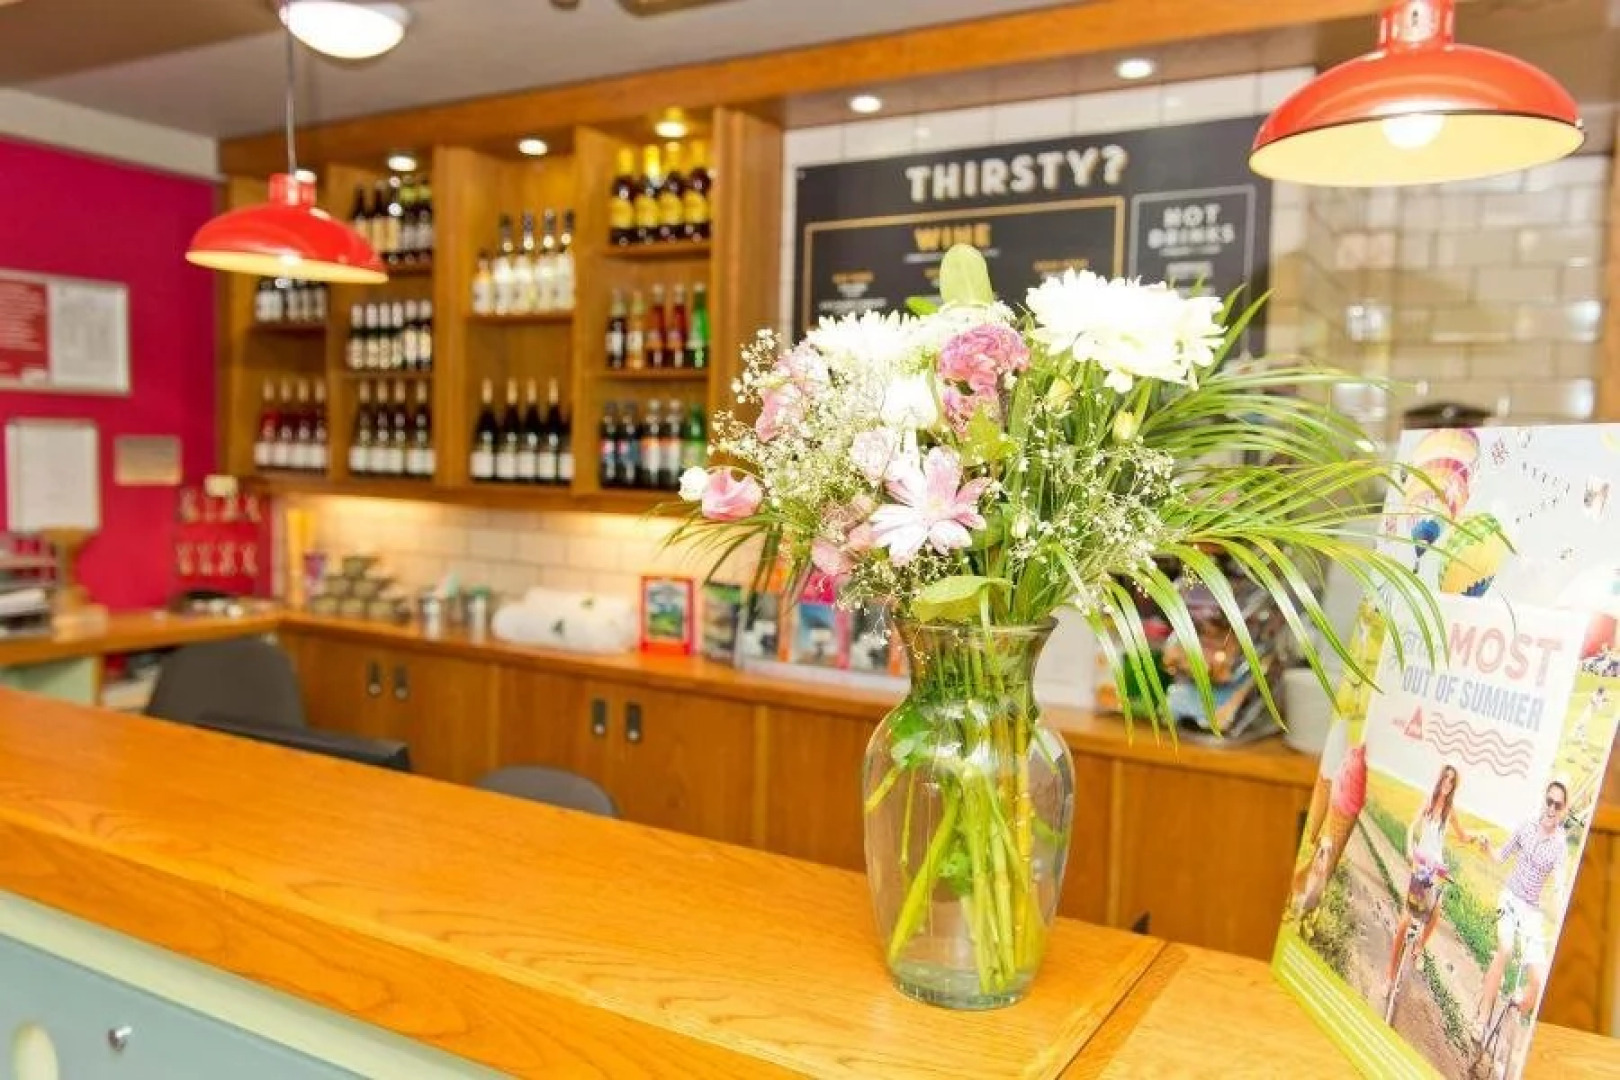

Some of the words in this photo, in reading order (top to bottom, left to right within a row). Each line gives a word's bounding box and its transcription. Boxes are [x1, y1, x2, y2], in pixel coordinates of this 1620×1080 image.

[905, 145, 1128, 202] THIRSTY?
[914, 222, 992, 251] WINE
[1148, 223, 1235, 249] DRINKS
[1163, 204, 1221, 228] HOT
[1449, 622, 1563, 687] MOST
[1402, 664, 1434, 698] OUT
[1435, 674, 1461, 705] OF
[1459, 679, 1545, 732] SUMMER
